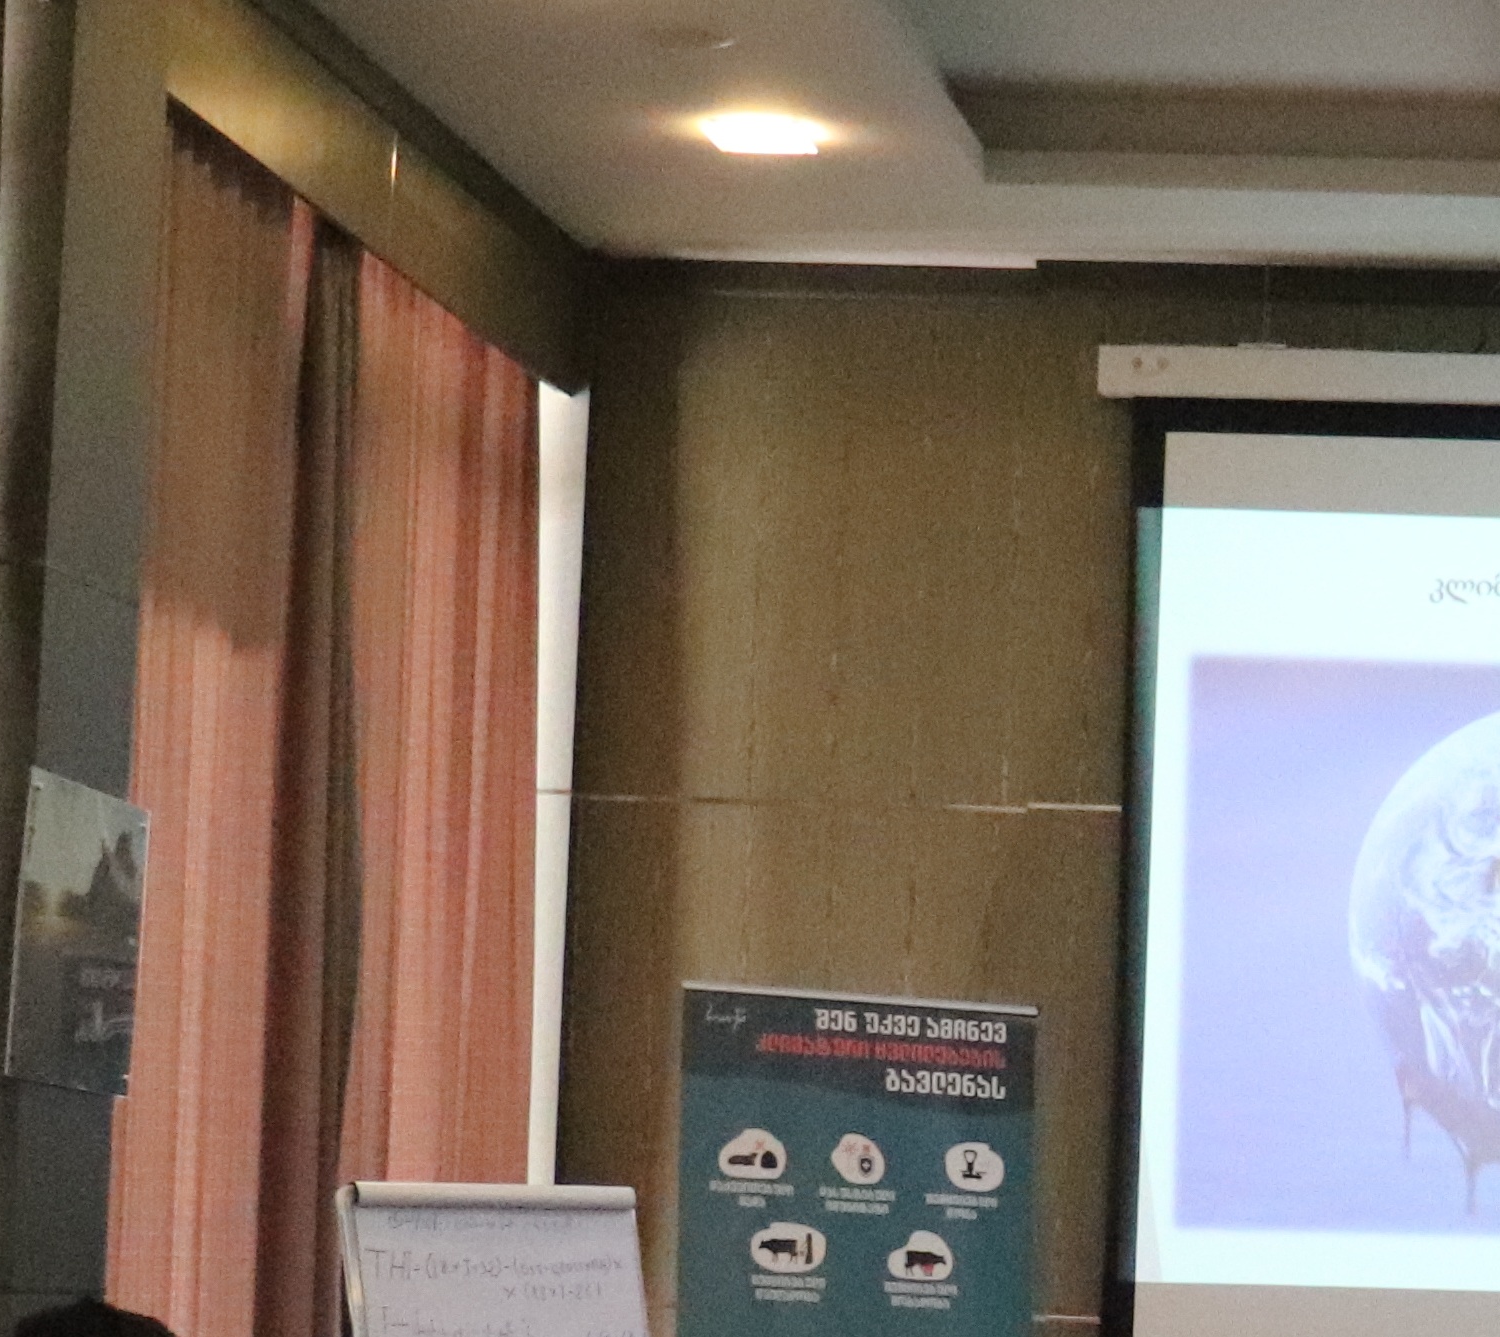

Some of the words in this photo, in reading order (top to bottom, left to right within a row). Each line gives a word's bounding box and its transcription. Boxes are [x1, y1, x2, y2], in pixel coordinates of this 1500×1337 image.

[815, 1008, 858, 1032] შენ
[864, 1013, 921, 1038] უკვე
[926, 1018, 1008, 1044] ამჩნევ
[884, 1067, 1007, 1100] გავლენას
